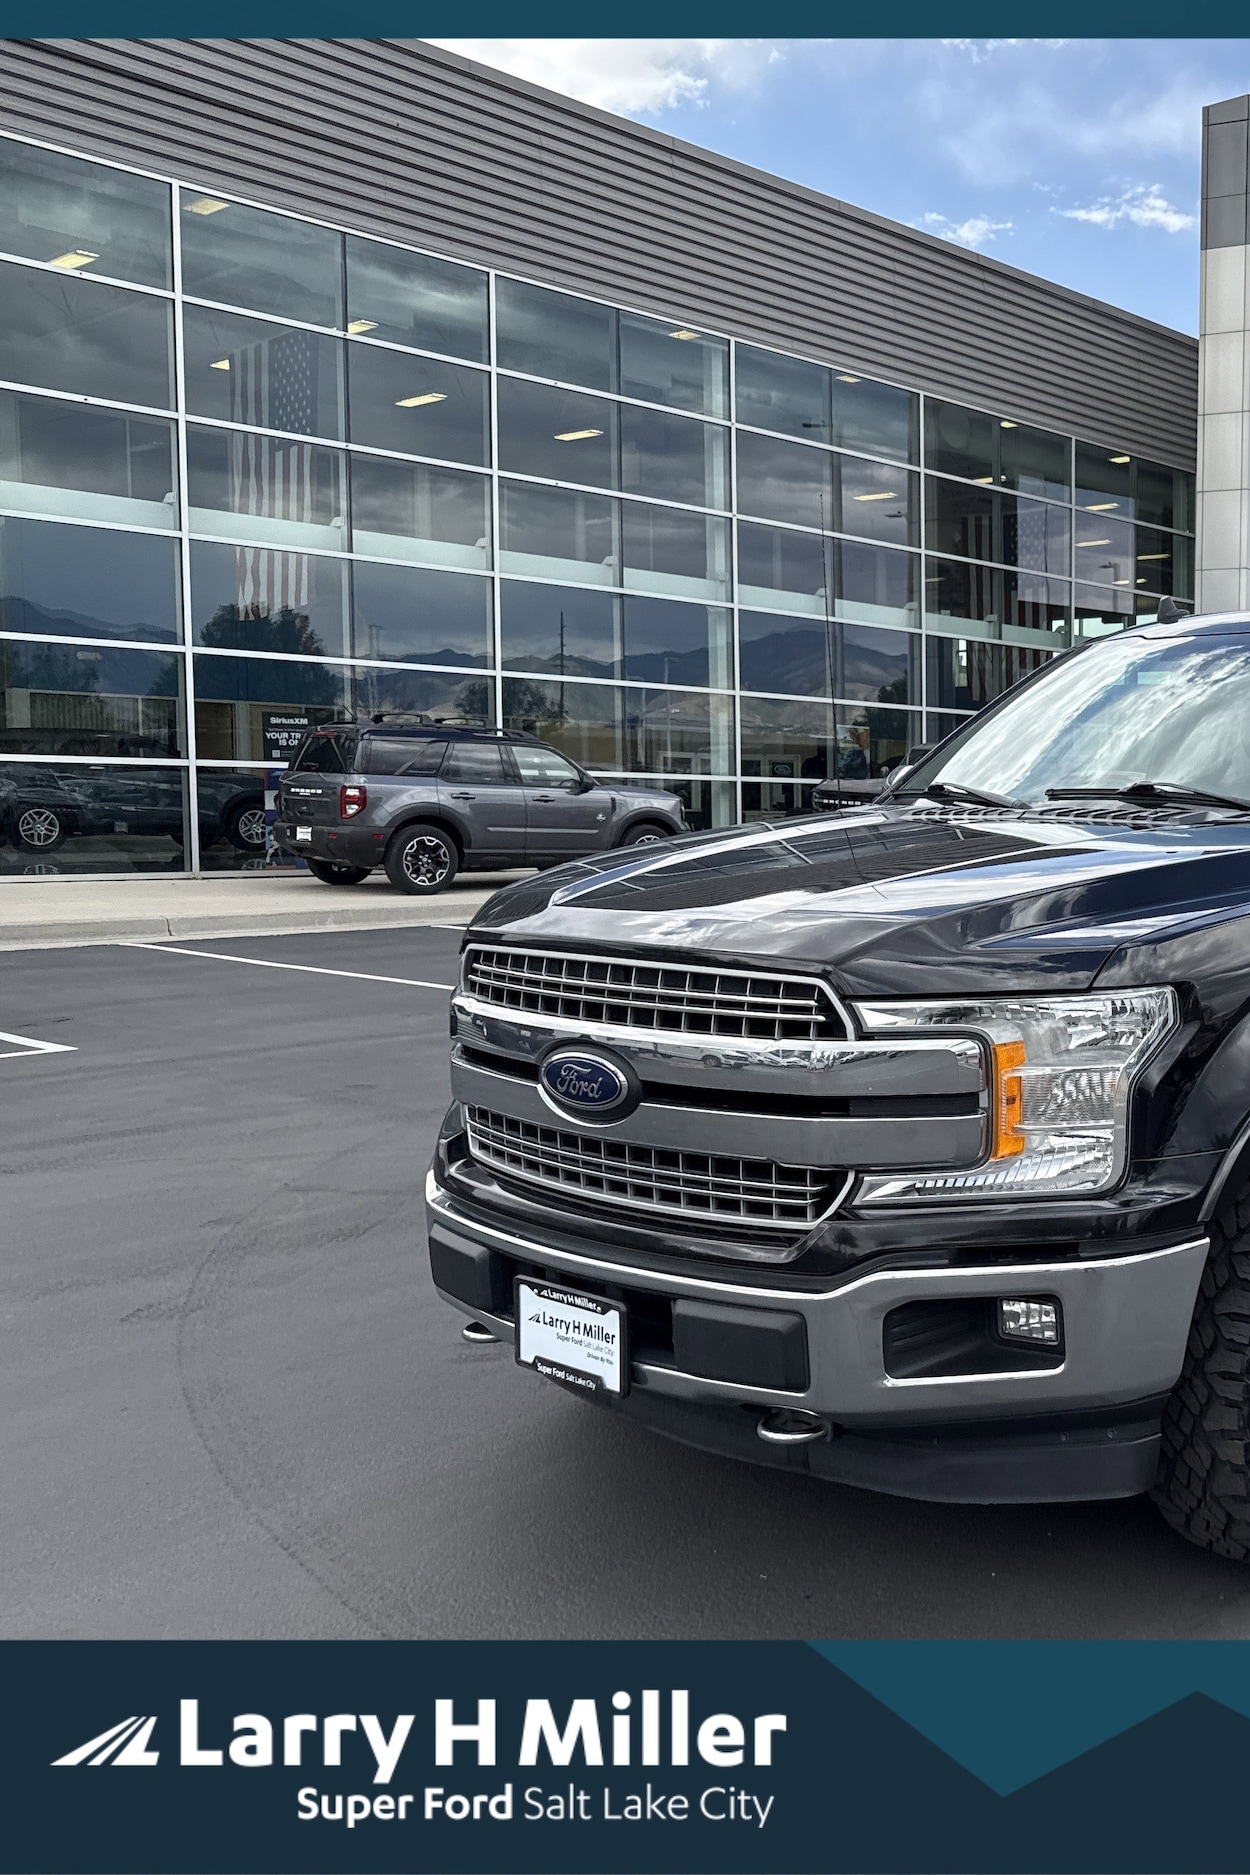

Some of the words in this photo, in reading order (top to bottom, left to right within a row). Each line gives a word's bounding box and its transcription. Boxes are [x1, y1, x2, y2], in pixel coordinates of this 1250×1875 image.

[269, 716, 309, 725] SiriusXM
[265, 732, 289, 740] YOUR
[556, 1063, 603, 1099] Ford
[547, 1288, 568, 1304] Larry
[567, 1294, 574, 1304] H
[575, 1296, 597, 1310] Miller
[543, 1311, 571, 1334] Larry
[573, 1320, 581, 1334] H
[583, 1323, 616, 1344] Miller
[556, 1332, 570, 1344] Super
[571, 1335, 583, 1346] Ford
[592, 1341, 603, 1352] Lake
[604, 1345, 614, 1357] City
[537, 1362, 552, 1375] Super
[552, 1367, 565, 1379] Ford
[565, 1372, 575, 1383] Salt
[575, 1375, 586, 1386] Lake
[586, 1379, 597, 1391] City
